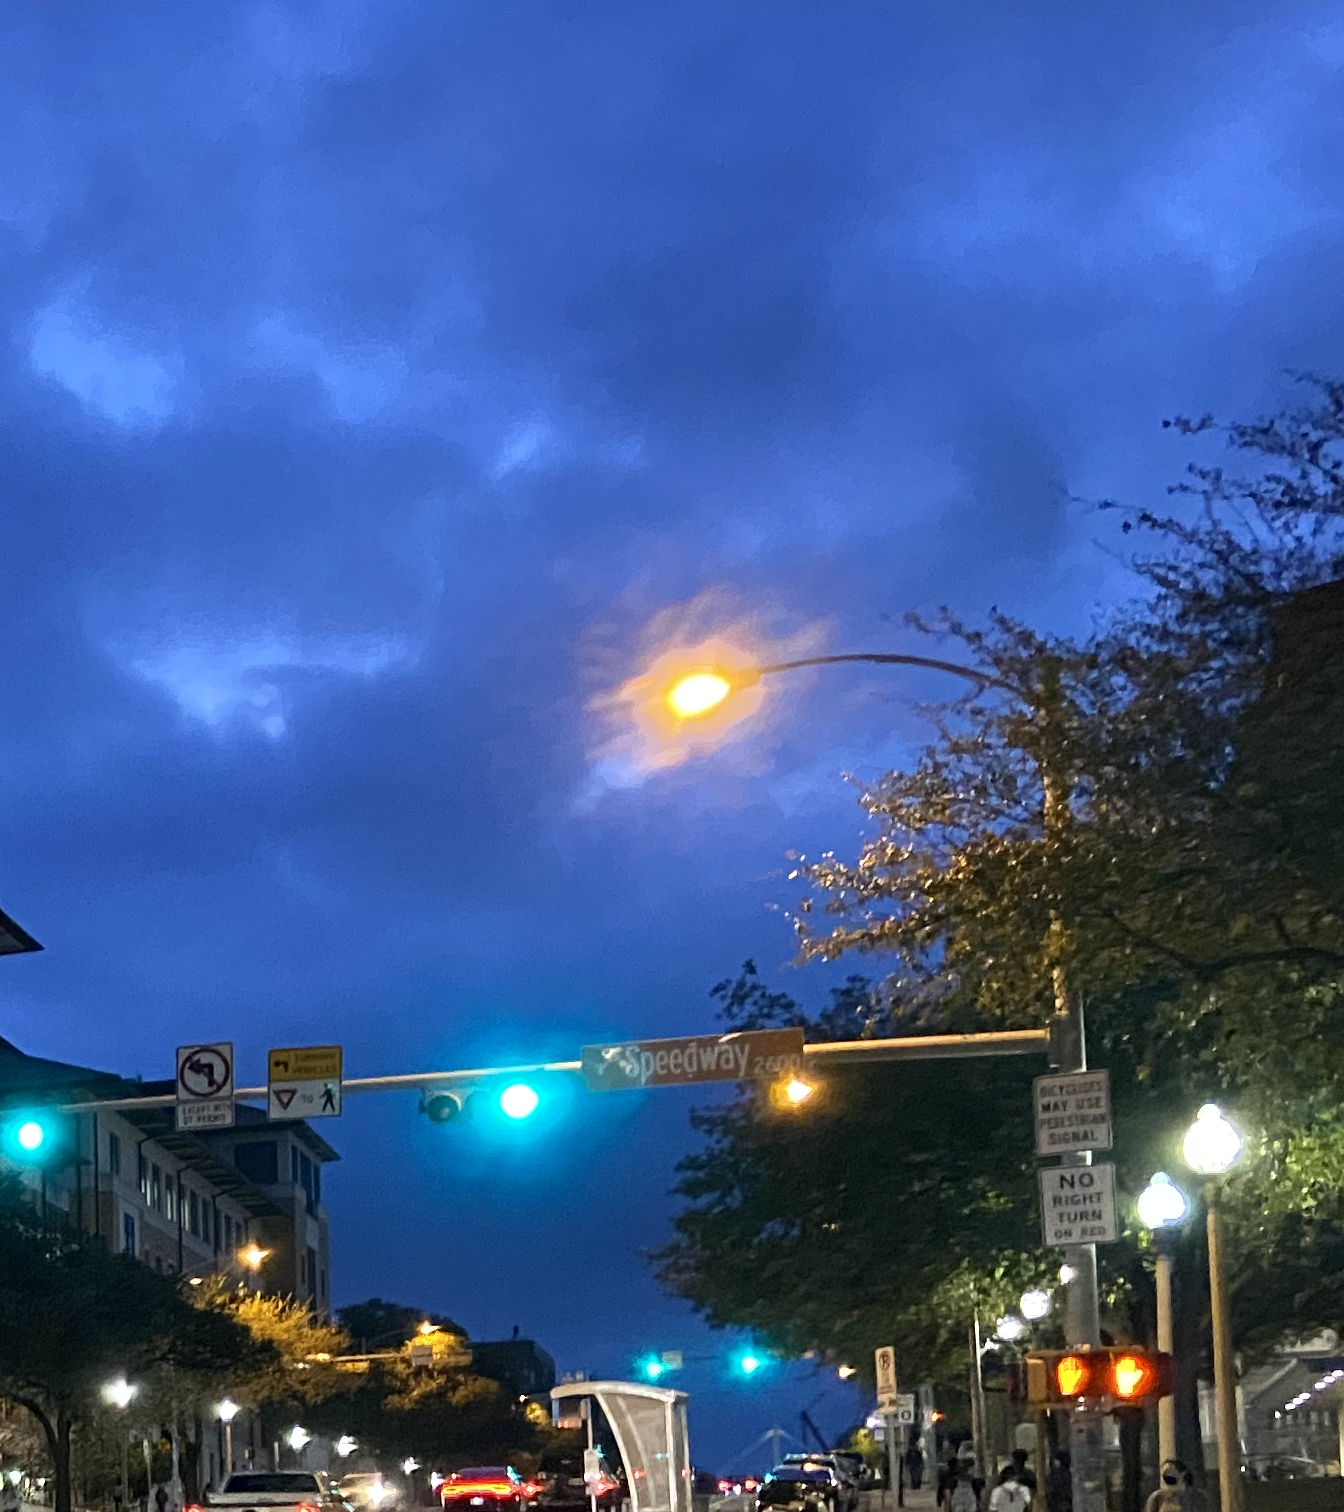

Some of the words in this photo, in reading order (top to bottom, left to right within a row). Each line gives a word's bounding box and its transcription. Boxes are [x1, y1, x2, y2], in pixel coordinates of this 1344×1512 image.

[624, 1041, 749, 1085] Speedway
[1041, 1100, 1068, 1113] MAY
[1075, 1096, 1102, 1110] USE
[1048, 1130, 1099, 1145] SIGNAL
[1060, 1173, 1094, 1190] NO
[1053, 1192, 1103, 1208] RIGHT
[1057, 1209, 1102, 1223] TURN
[1054, 1229, 1073, 1240] ON
[1080, 1226, 1106, 1238] RED
